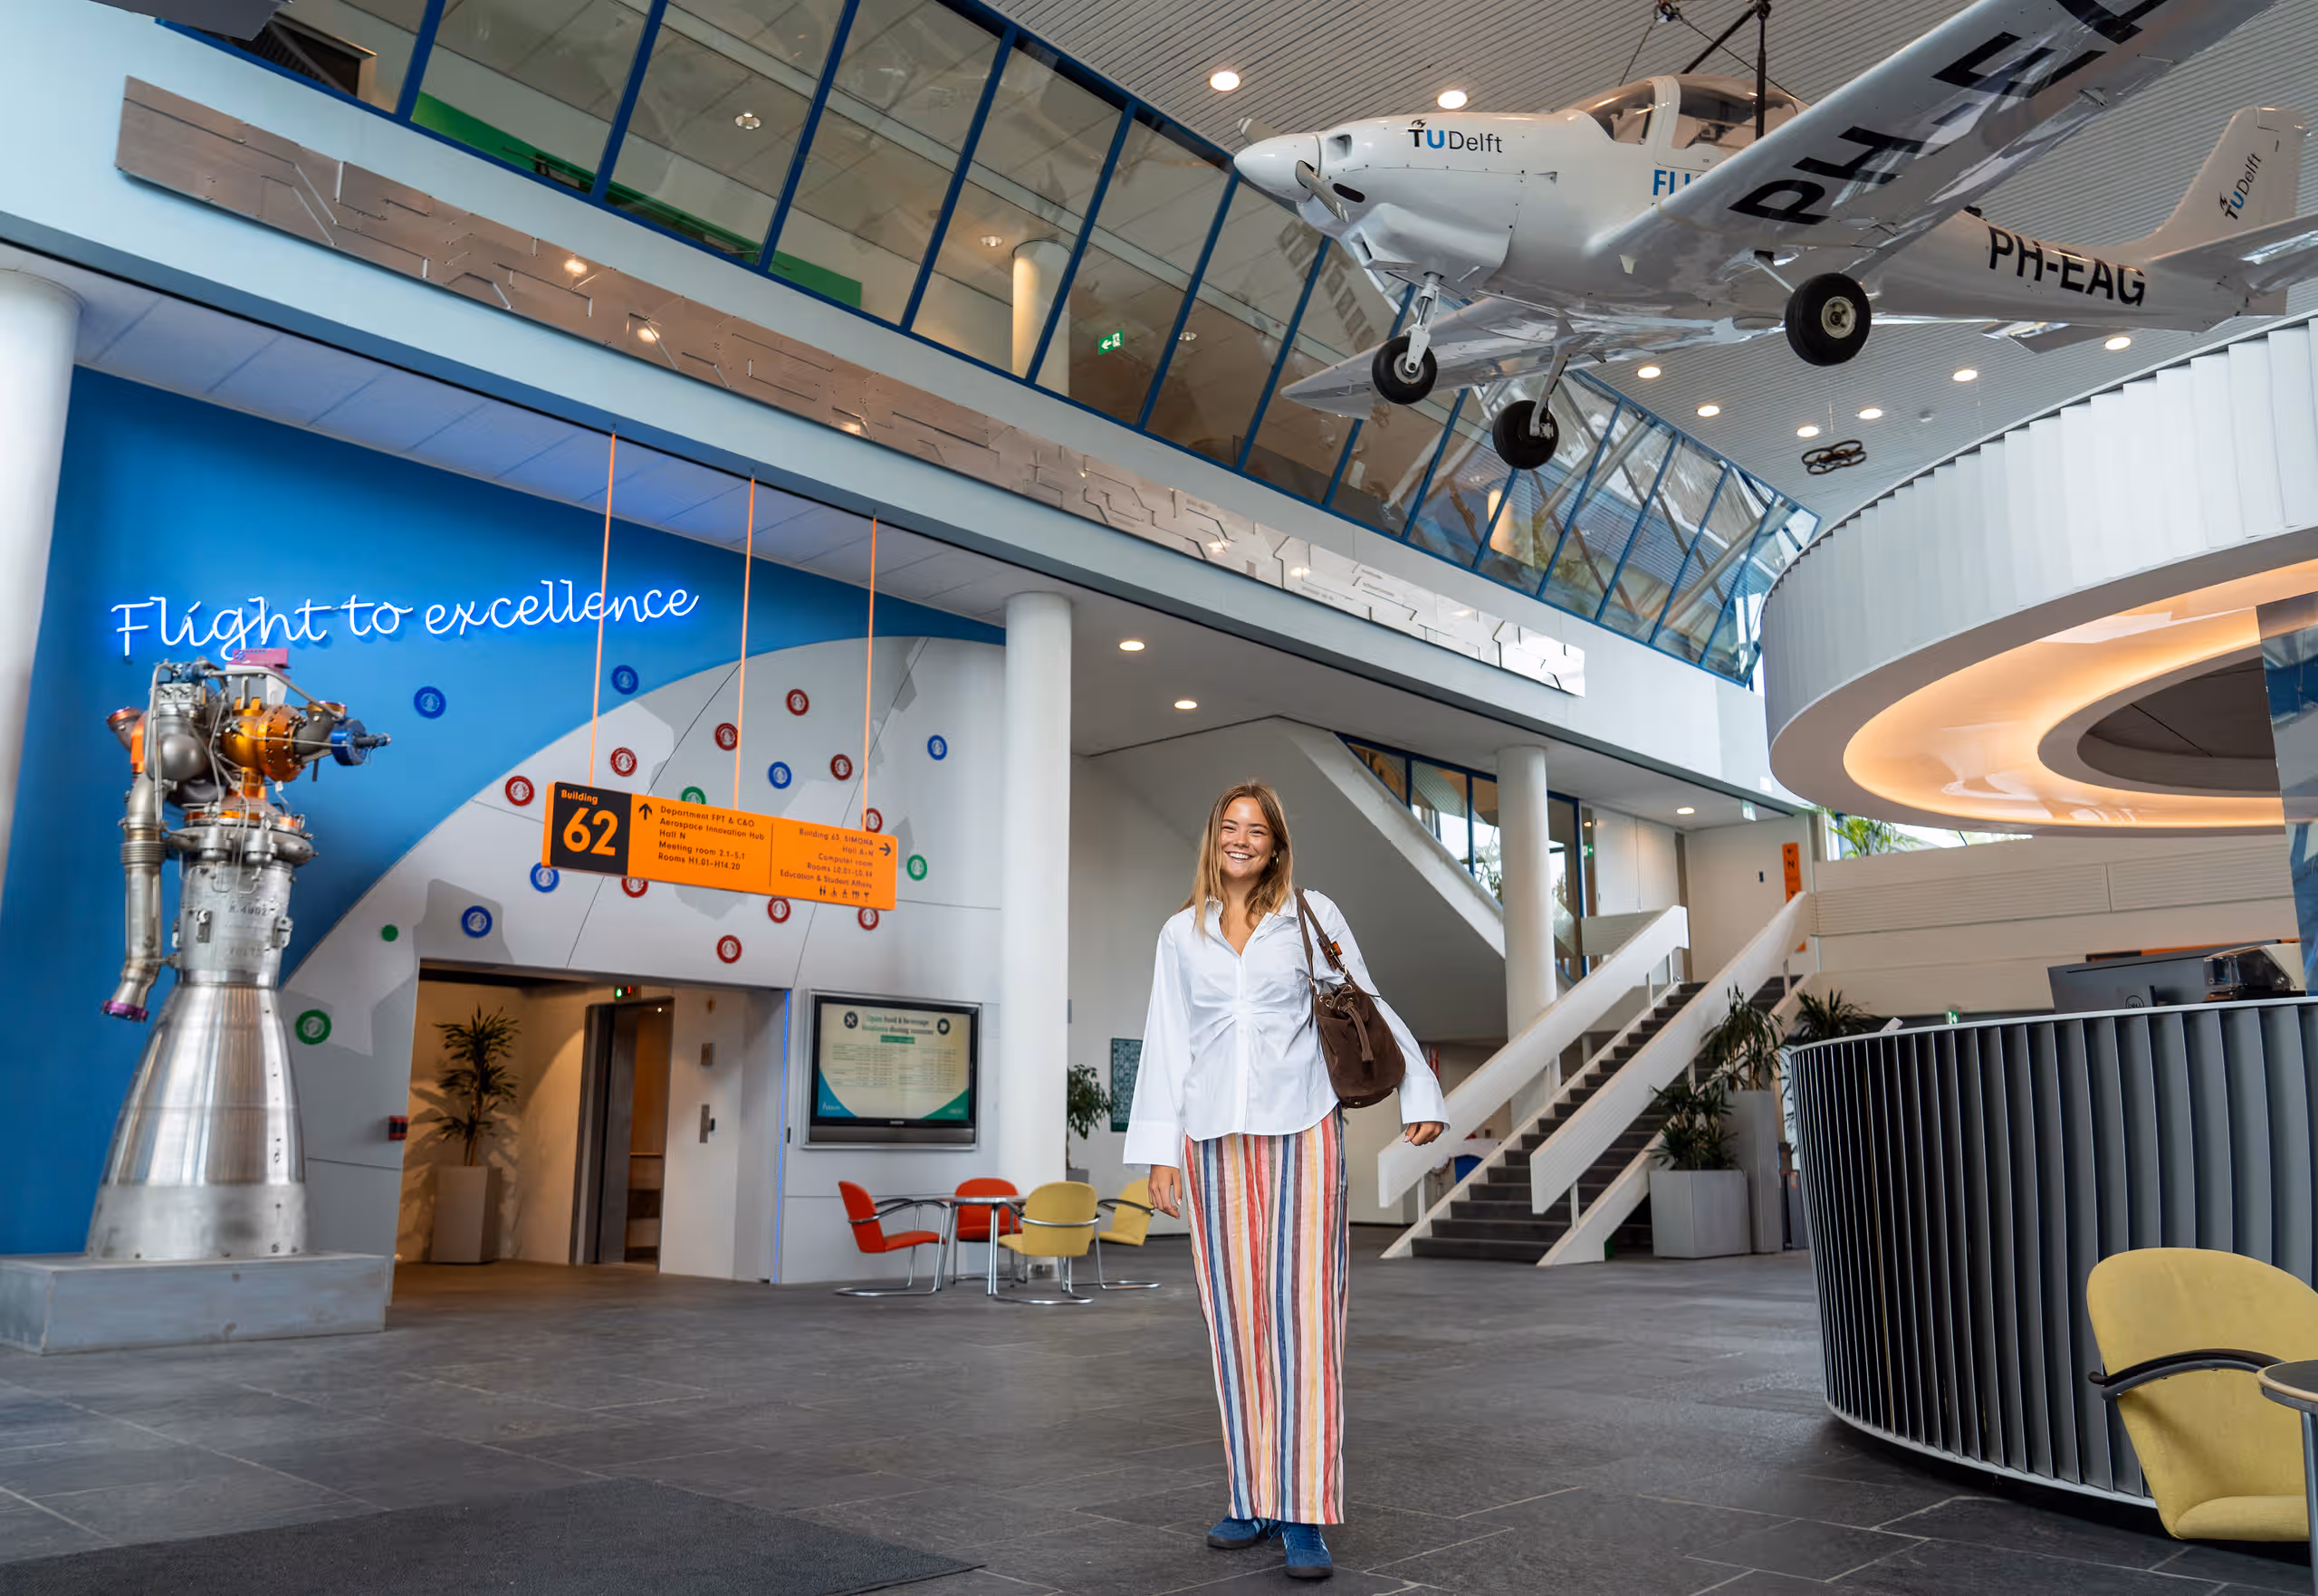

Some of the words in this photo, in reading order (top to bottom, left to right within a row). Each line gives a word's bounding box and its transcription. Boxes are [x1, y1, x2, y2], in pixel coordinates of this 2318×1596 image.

[1988, 225, 2145, 306] PH-EAG
[110, 595, 331, 662] Flight
[338, 593, 414, 636] to
[425, 578, 701, 637] excellence
[560, 789, 599, 806] Building
[660, 805, 709, 820] Department
[712, 813, 725, 823] FPT
[728, 817, 734, 825] &
[562, 807, 618, 856] 62
[659, 817, 704, 831] Aerospace
[706, 825, 747, 837] Innovation
[749, 831, 764, 840] Hub
[659, 829, 676, 838] Hall
[799, 827, 829, 840] Building
[845, 835, 874, 846] SIMONA
[658, 840, 693, 854] Meeting
[695, 847, 716, 855] room
[658, 852, 685, 863] Rooms
[818, 853, 853, 864] Computer
[780, 869, 814, 881] Education
